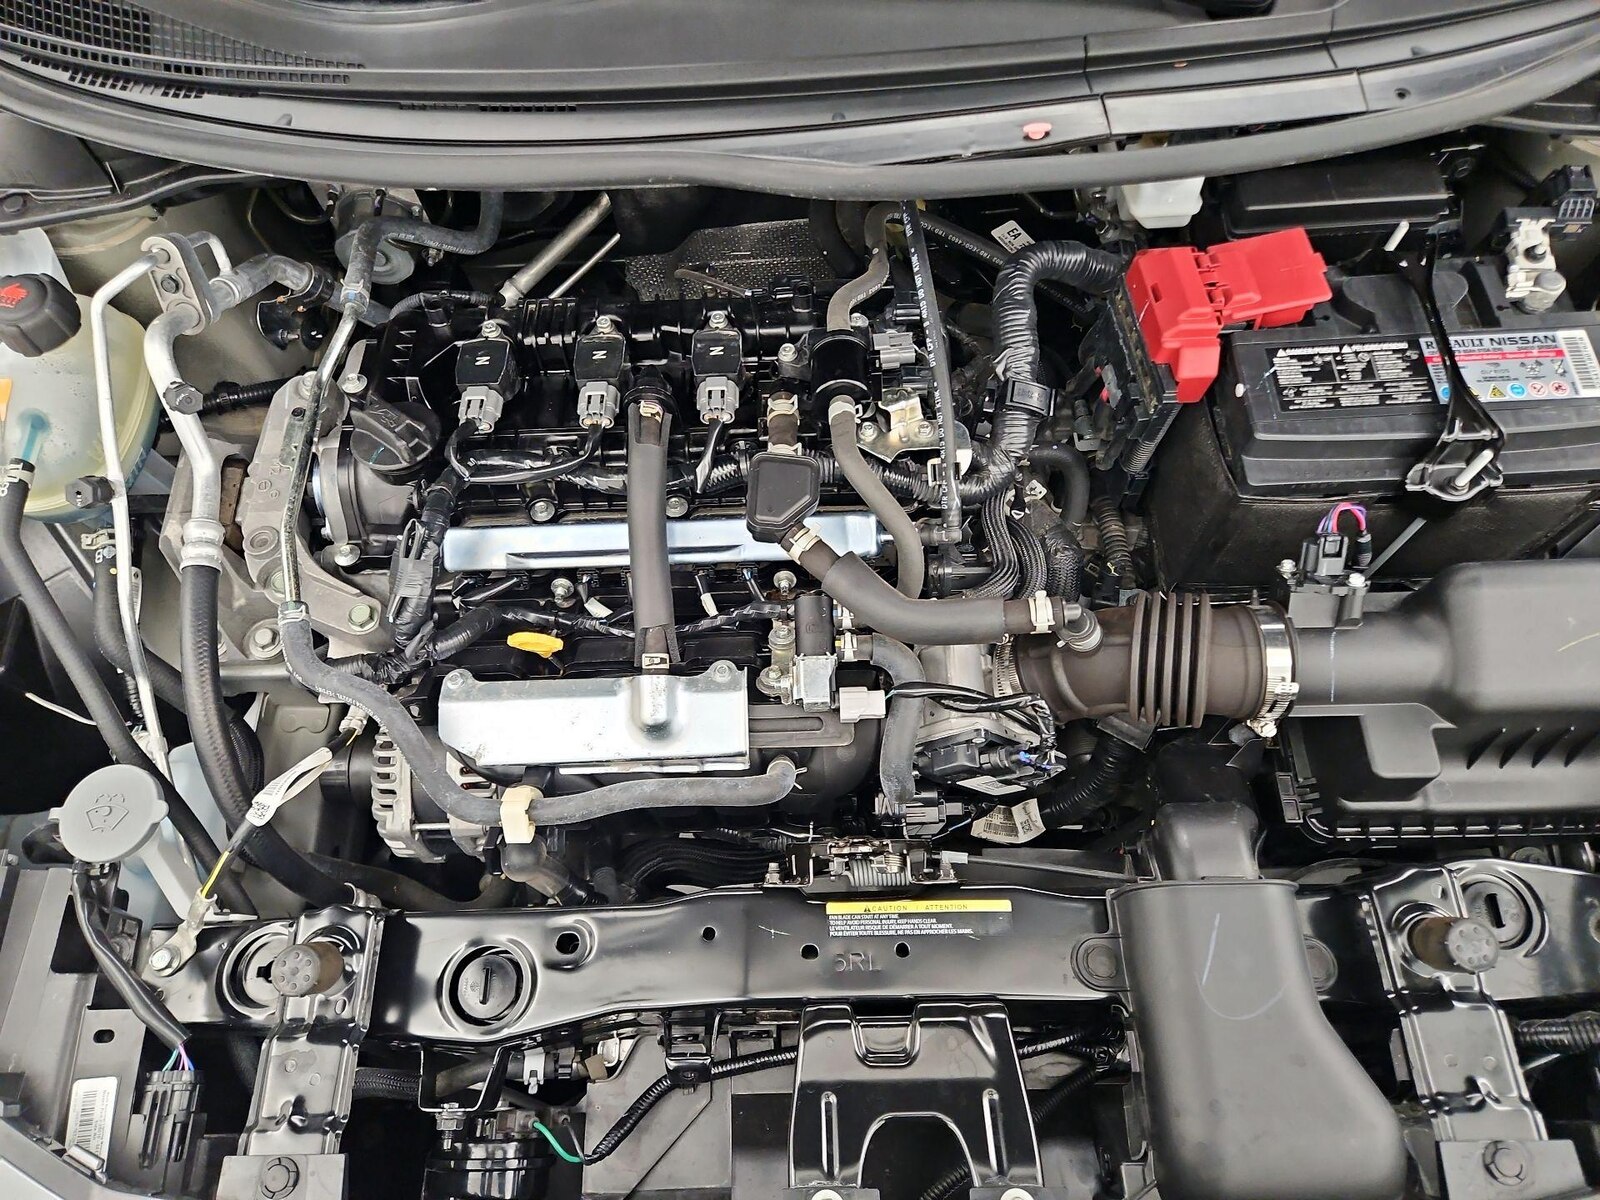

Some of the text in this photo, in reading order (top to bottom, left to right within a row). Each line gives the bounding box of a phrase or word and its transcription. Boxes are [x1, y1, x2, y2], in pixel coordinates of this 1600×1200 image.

[1006, 227, 1022, 241] EA
[1425, 334, 1557, 350] RAULT NISSAN
